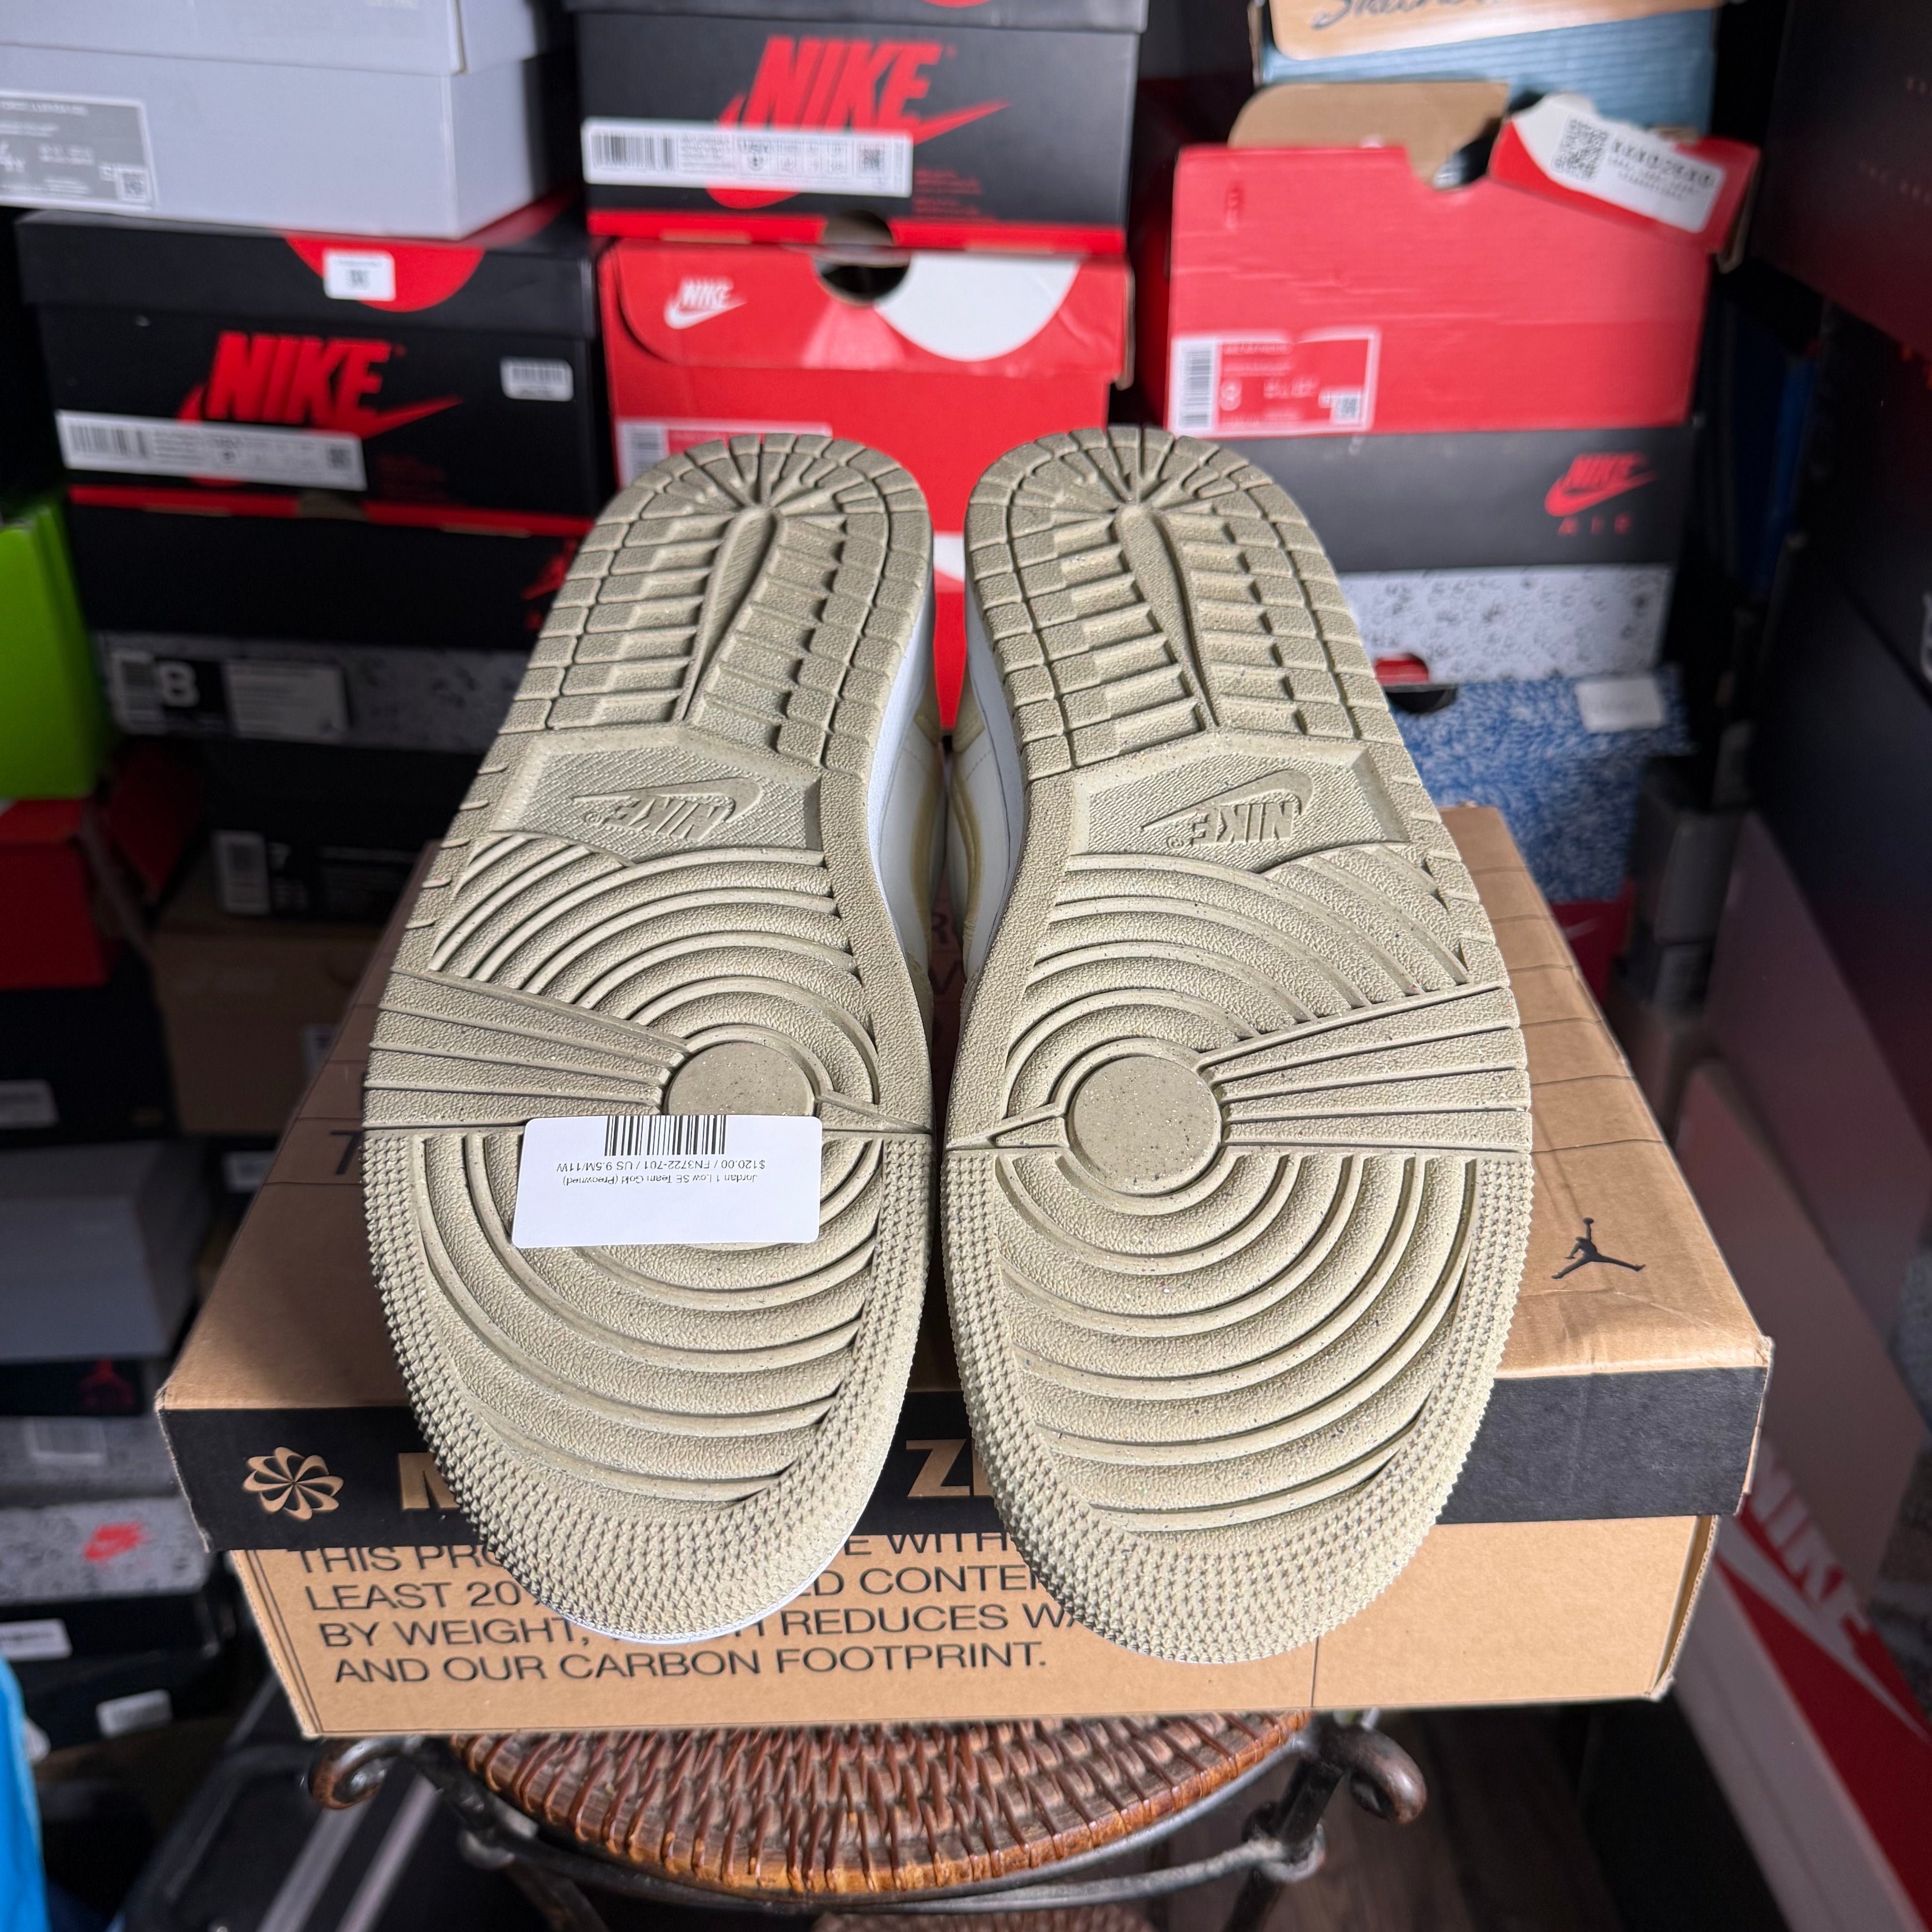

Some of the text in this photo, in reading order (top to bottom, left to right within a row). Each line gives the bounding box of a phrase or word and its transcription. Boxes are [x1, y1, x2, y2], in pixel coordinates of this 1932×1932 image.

[741, 34, 944, 138] NIKE
[679, 277, 735, 307] NIKE
[204, 331, 392, 424] NIKE
[604, 795, 730, 843] NIKE
[1191, 801, 1295, 848] NIKE
[556, 1161, 613, 1172] 9.5M/11W
[616, 1161, 633, 1170] US
[644, 1160, 710, 1170] FN3722-701
[721, 1159, 766, 1170] $120.00
[562, 1173, 618, 1186] (Preowned)
[621, 1175, 644, 1184] Gold
[647, 1175, 672, 1184] Team
[676, 1174, 690, 1183] SE
[692, 1174, 712, 1183] Low
[724, 1174, 758, 1183] Jordan
[287, 1546, 402, 1573] THIS
[304, 1581, 452, 1611] LEAST
[466, 1580, 543, 1607] 20
[318, 1621, 380, 1648] BY
[393, 1616, 589, 1646] WEIGHT,
[780, 1603, 1009, 1636] REDUCES
[336, 1641, 1046, 1683] AND OUR CARBON FOOTPRINT.
